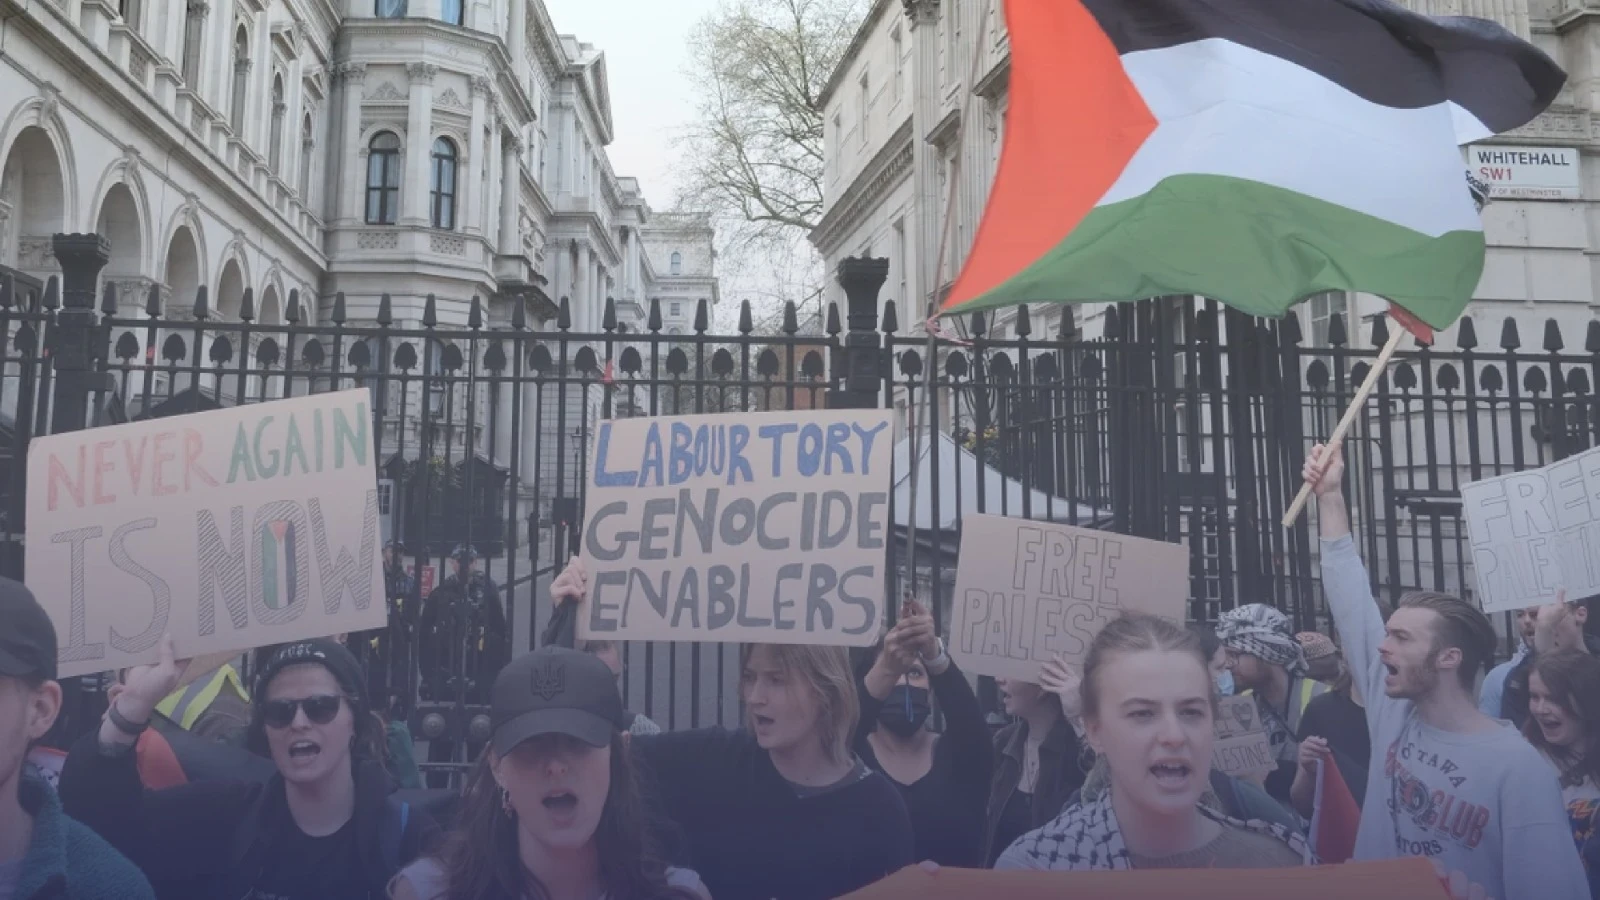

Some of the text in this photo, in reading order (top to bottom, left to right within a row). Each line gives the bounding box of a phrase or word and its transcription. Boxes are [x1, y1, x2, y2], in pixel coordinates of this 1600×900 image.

[1477, 151, 1570, 166] WHITEHALL
[1480, 167, 1512, 181] SW1
[47, 402, 367, 512] NEVER AGAIN
[593, 420, 889, 488] LABOUR TORY
[585, 487, 888, 561] GENOCIDE
[50, 488, 380, 663] IS NOW
[589, 562, 876, 635] ENABLERS
[1012, 526, 1123, 606] FREE
